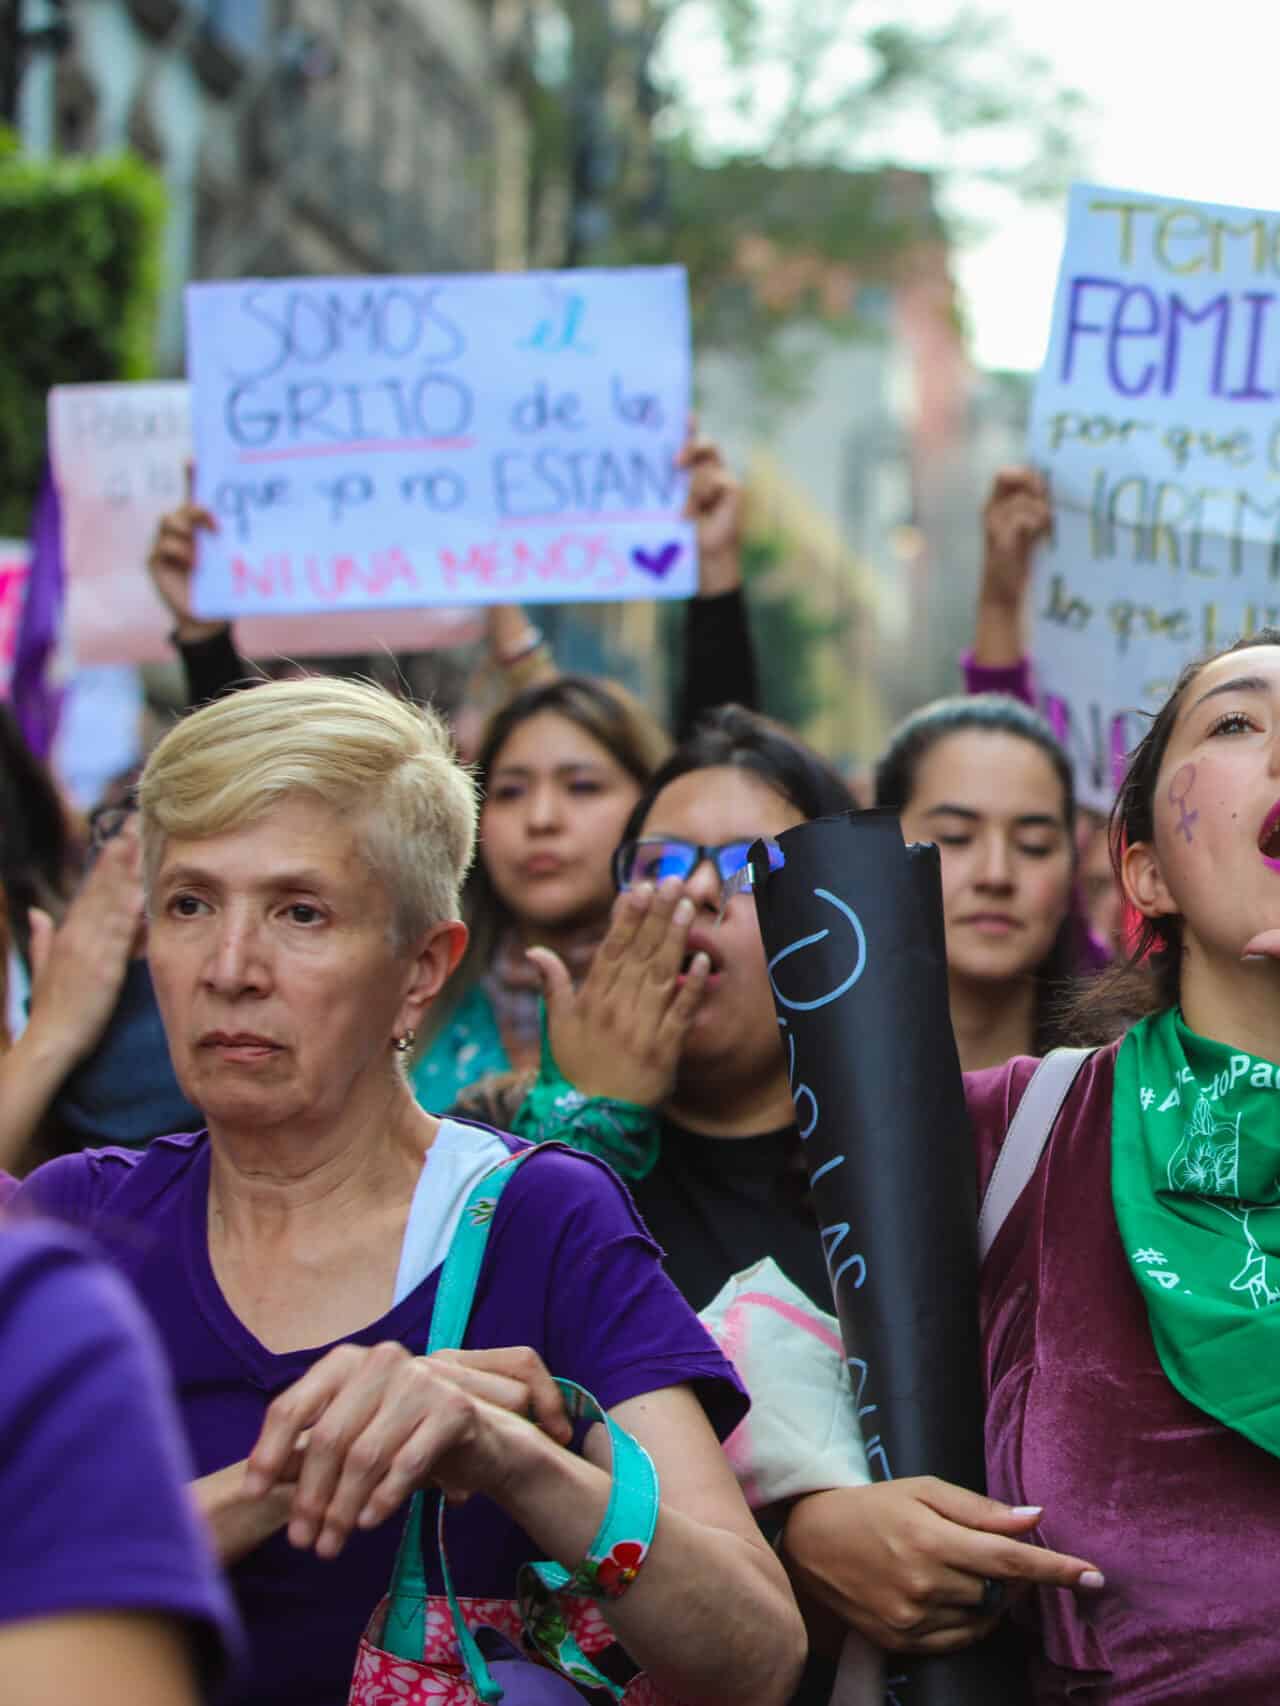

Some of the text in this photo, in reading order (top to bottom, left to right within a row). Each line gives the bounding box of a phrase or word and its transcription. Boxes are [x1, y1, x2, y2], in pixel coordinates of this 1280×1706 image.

[226, 286, 468, 378] SOMOS
[226, 372, 476, 448] GRITO
[510, 378, 586, 434] de
[1046, 410, 1150, 460] por
[1162, 424, 1254, 472] que
[214, 474, 292, 542] que
[438, 532, 628, 590] MENOS
[1106, 600, 1192, 656] que
